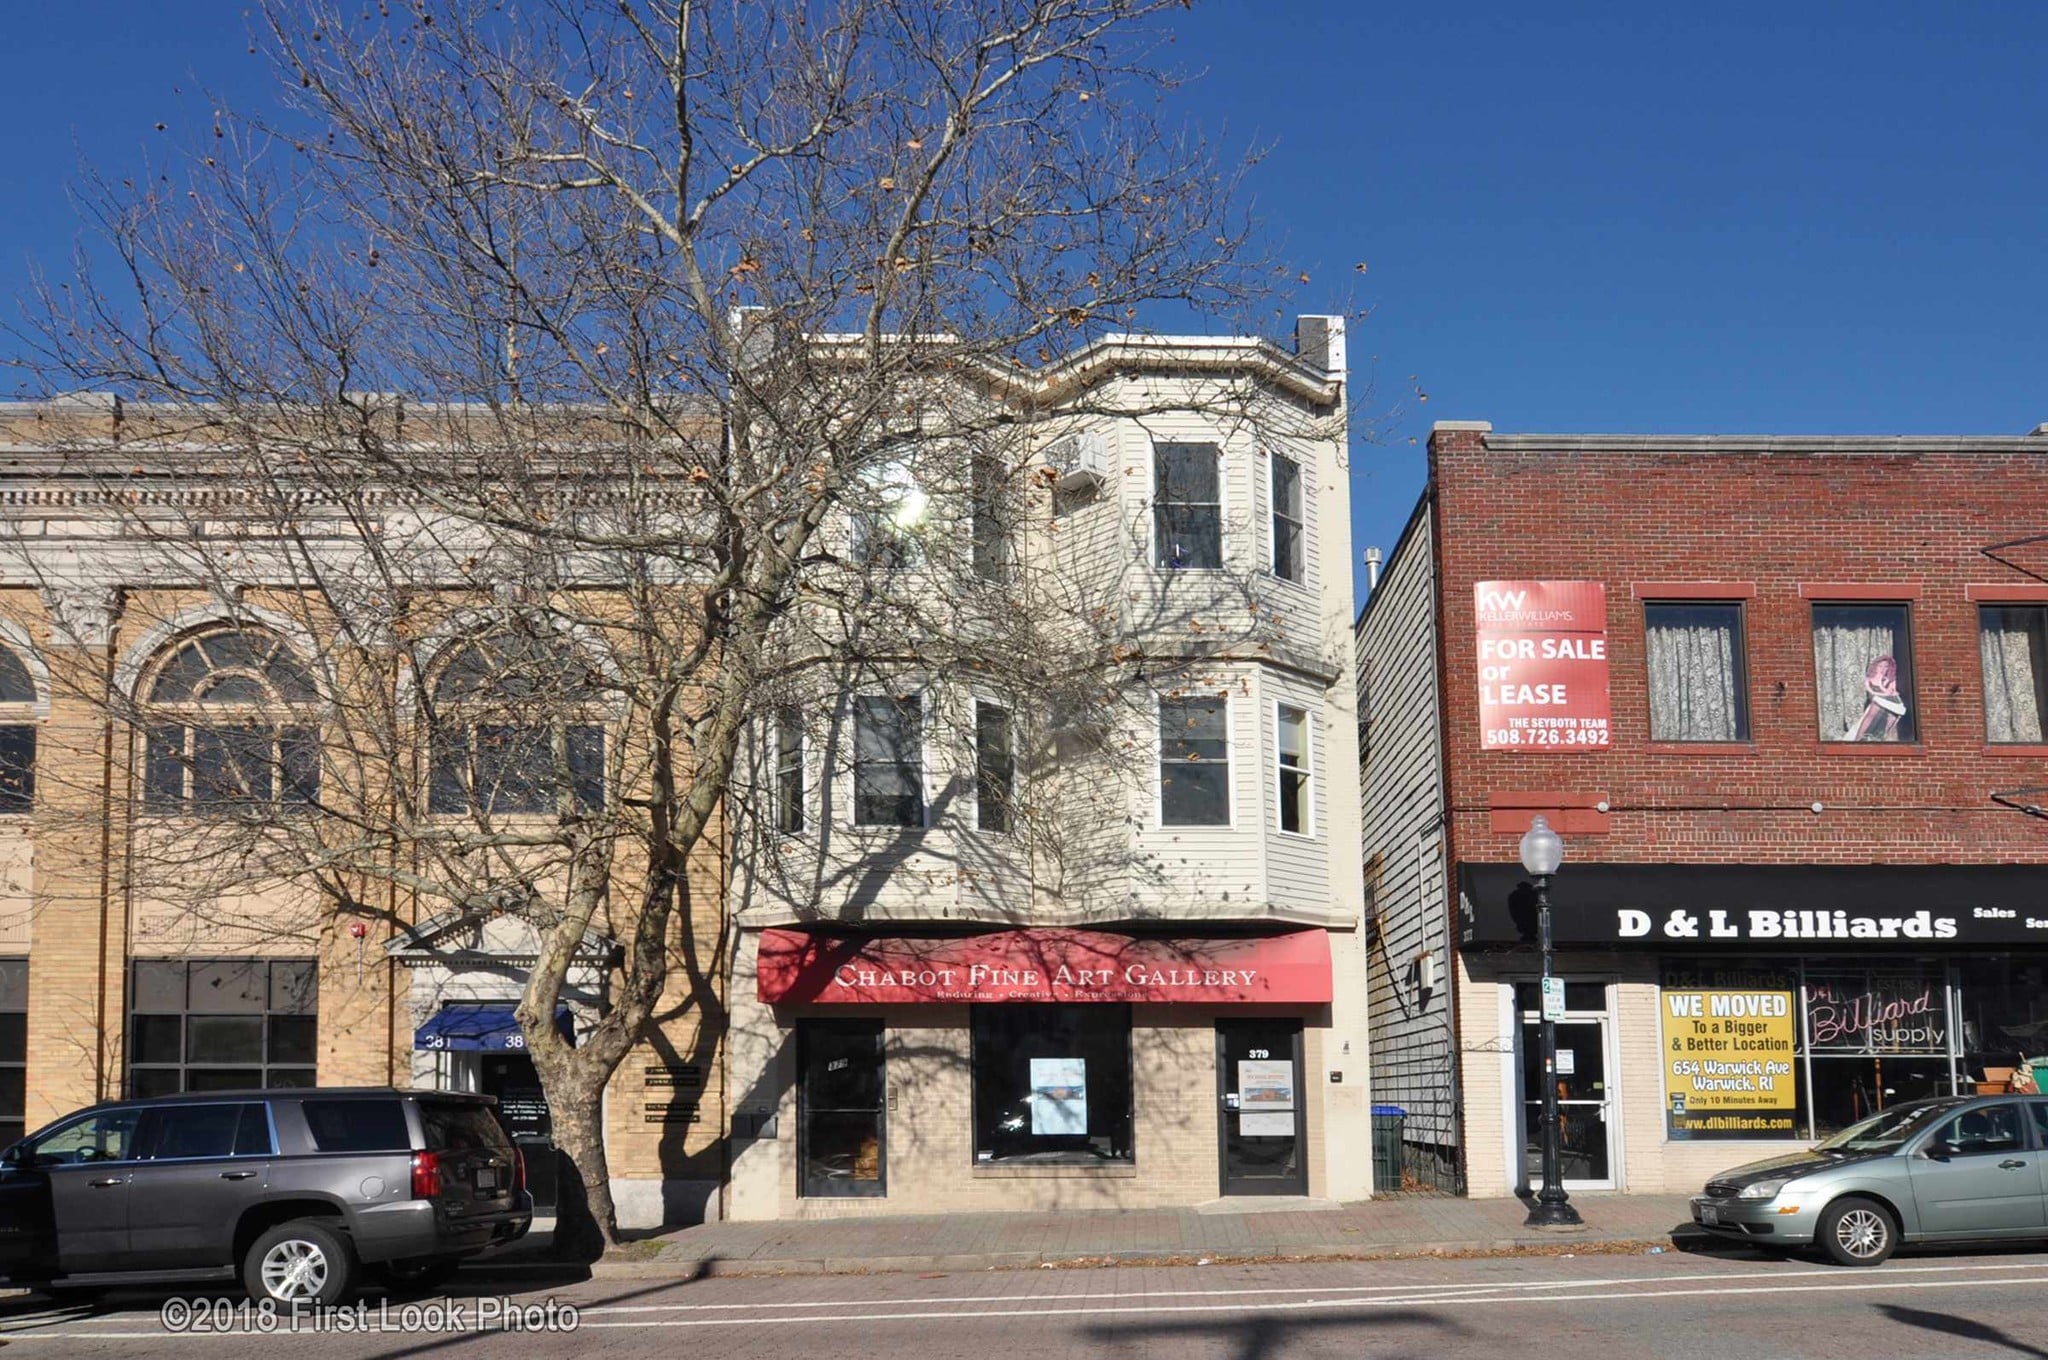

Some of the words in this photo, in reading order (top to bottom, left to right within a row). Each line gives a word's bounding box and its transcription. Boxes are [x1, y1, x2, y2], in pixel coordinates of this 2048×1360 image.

[1481, 639, 1536, 660] FOR
[1541, 639, 1606, 660] SALE
[1482, 666, 1510, 681] or
[1482, 684, 1567, 705] LEASE
[1509, 717, 1529, 729] THE
[1531, 717, 1577, 729] SEYBOTH
[1579, 718, 1607, 729] TEAM
[1487, 729, 1609, 745] 508.726.3492
[1973, 907, 2017, 918] Sales
[1617, 909, 1652, 937] D
[1663, 909, 1699, 937] &
[1709, 910, 1738, 937] L
[1748, 910, 1958, 938] Billiards
[834, 964, 957, 987] CHABOT
[969, 964, 1039, 987] FINE
[1052, 963, 1115, 986] ART
[1124, 963, 1257, 986] GALLERY
[936, 990, 993, 1000] Enduring
[1668, 994, 1704, 1017] WE
[1710, 994, 1787, 1017] MOVED
[1808, 982, 1943, 1046] Billiard
[1692, 1020, 1707, 1034] To
[1711, 1023, 1720, 1034] a
[1724, 1020, 1768, 1036] Bigger
[1872, 1026, 1945, 1044] supply
[425, 1035, 451, 1048] 381
[505, 1035, 528, 1048] 38
[1672, 1037, 1682, 1051] &
[1687, 1037, 1729, 1051] Better
[1733, 1037, 1789, 1051] Location
[1248, 1049, 1270, 1059] 379
[1673, 1060, 1700, 1075] 654
[1703, 1060, 1762, 1075] Warwick
[1765, 1060, 1790, 1075] Ave
[1758, 1076, 1774, 1091] RI
[1689, 1096, 1707, 1105] Only
[1710, 1096, 1721, 1104] 10
[1723, 1096, 1756, 1104] Minutes
[1758, 1096, 1778, 1105] Away
[1683, 1116, 1793, 1129] ww.dlbilliards.com
